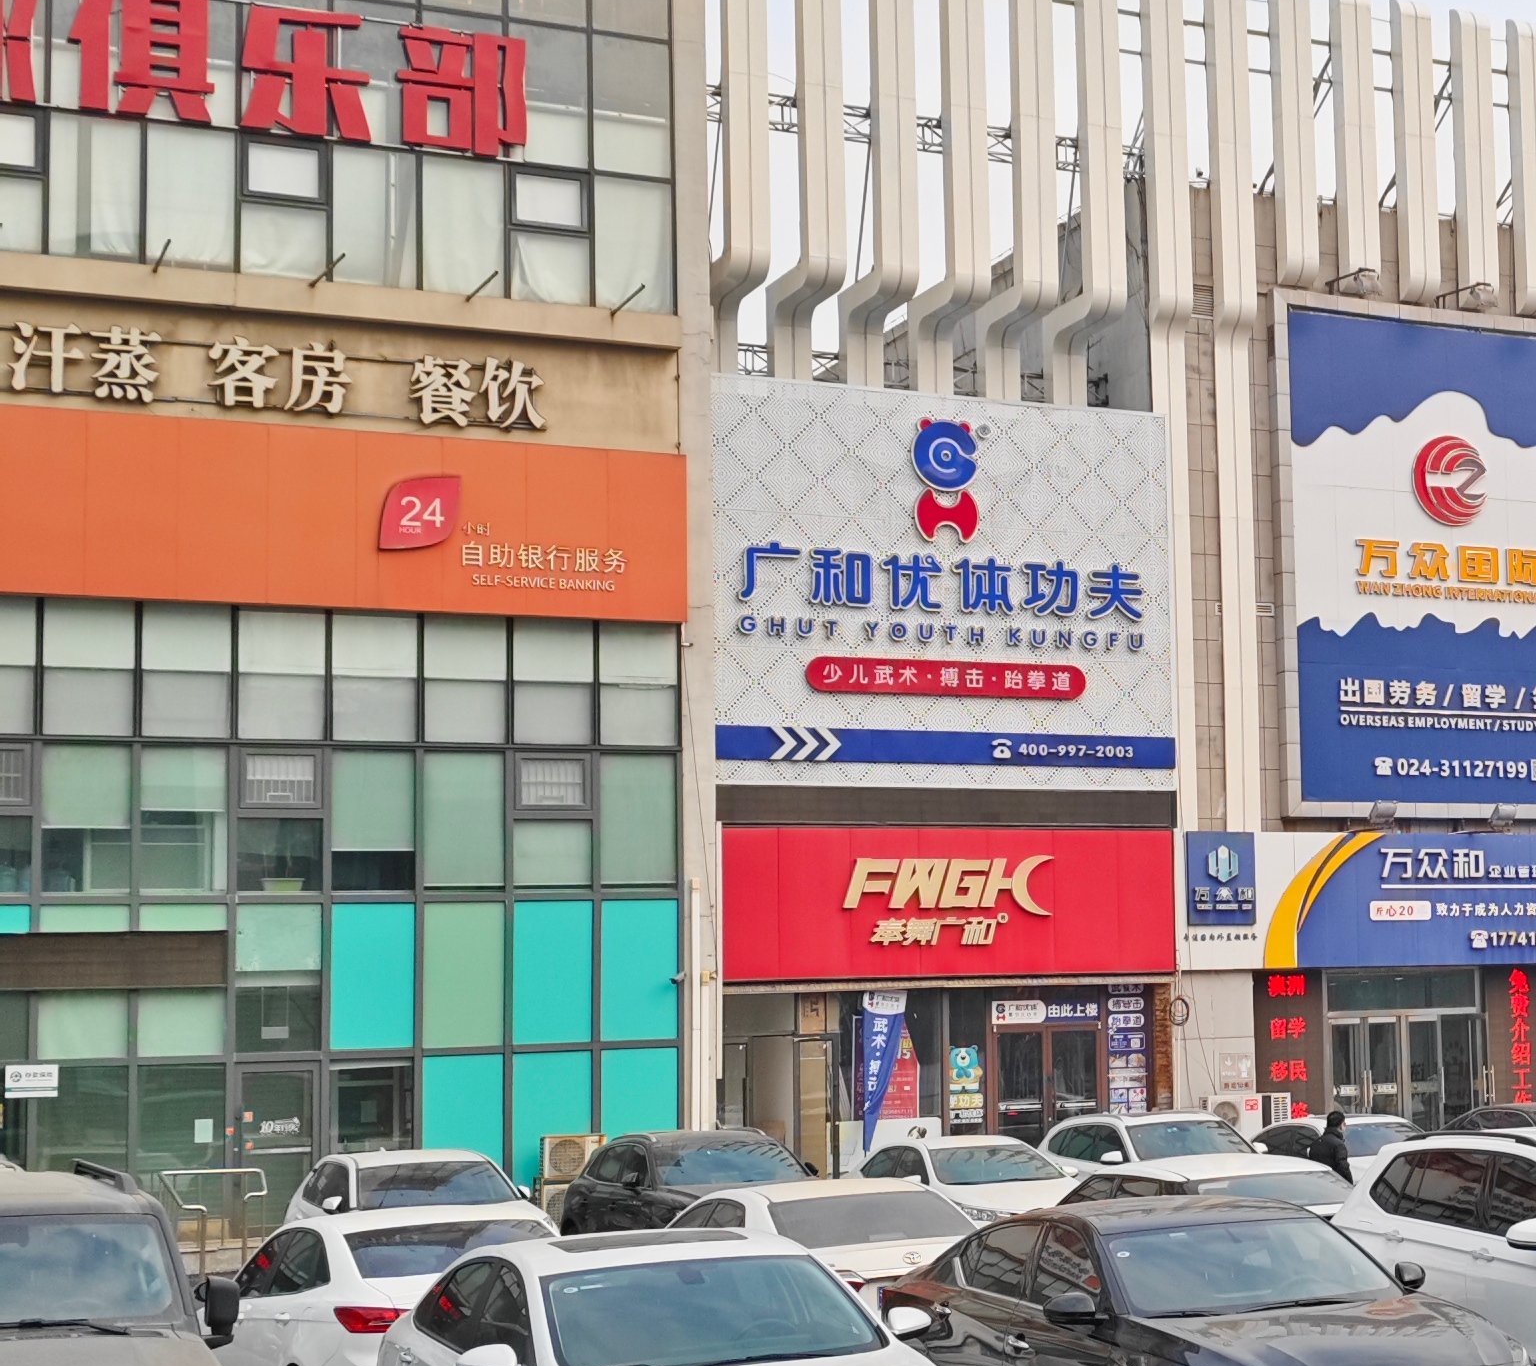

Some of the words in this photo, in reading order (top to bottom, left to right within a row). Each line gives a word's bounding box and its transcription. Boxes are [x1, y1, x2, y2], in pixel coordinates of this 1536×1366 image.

[12, 321, 161, 403] 汗蒸
[208, 336, 352, 414] 客房
[409, 355, 547, 431] 餐饮
[400, 496, 444, 527] 24
[462, 522, 490, 536] 小时
[461, 540, 627, 574] 自助银行服务
[472, 574, 556, 589] SELF-SERVICE
[558, 578, 615, 592] BANKING
[738, 540, 1145, 621] 广和优体功夫
[1357, 580, 1391, 595] WAN
[1392, 582, 1442, 599] ZHONG
[738, 615, 838, 638] GHUT
[866, 621, 987, 646] YOUTH
[1008, 626, 1146, 652] KUNGFU
[1340, 714, 1405, 728] OVERSEAS
[1407, 716, 1493, 732] EMPLOYMENT
[1018, 741, 1135, 759] 400-997-2003
[1397, 758, 1528, 779] 024-31127199
[1380, 847, 1485, 879] 万众和
[1194, 886, 1255, 901] 万众和
[1268, 975, 1306, 997] 澳洲
[1047, 1002, 1098, 1018] 由此上楼
[1269, 1016, 1308, 1040] 留学
[1269, 1059, 1309, 1083] 移民
